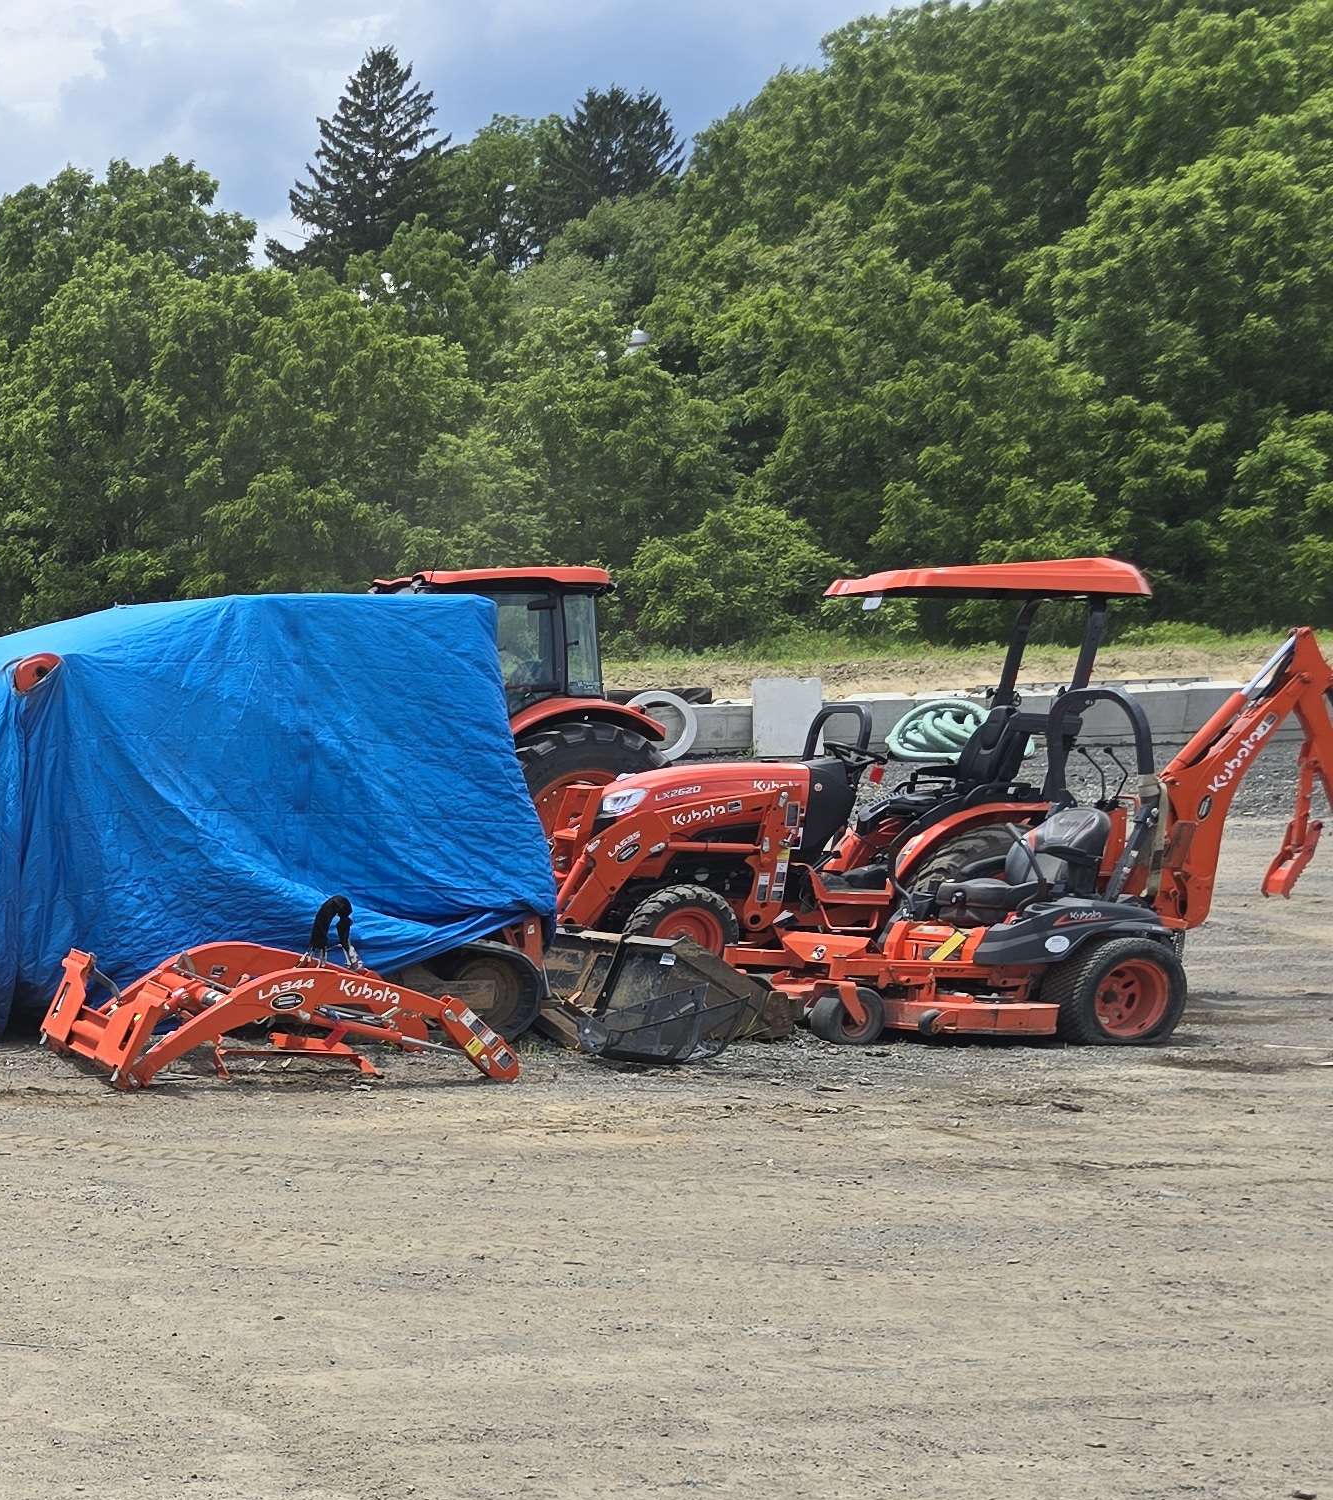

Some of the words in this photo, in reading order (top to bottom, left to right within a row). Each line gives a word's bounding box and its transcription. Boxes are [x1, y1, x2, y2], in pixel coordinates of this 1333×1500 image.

[1207, 730, 1264, 792] Kubota
[654, 785, 702, 801] LX2620
[753, 780, 799, 792] Kub
[671, 804, 726, 825] Kubota
[1069, 909, 1102, 920] Kubota
[258, 978, 315, 1000] LA344
[339, 979, 400, 1004] Kubota
